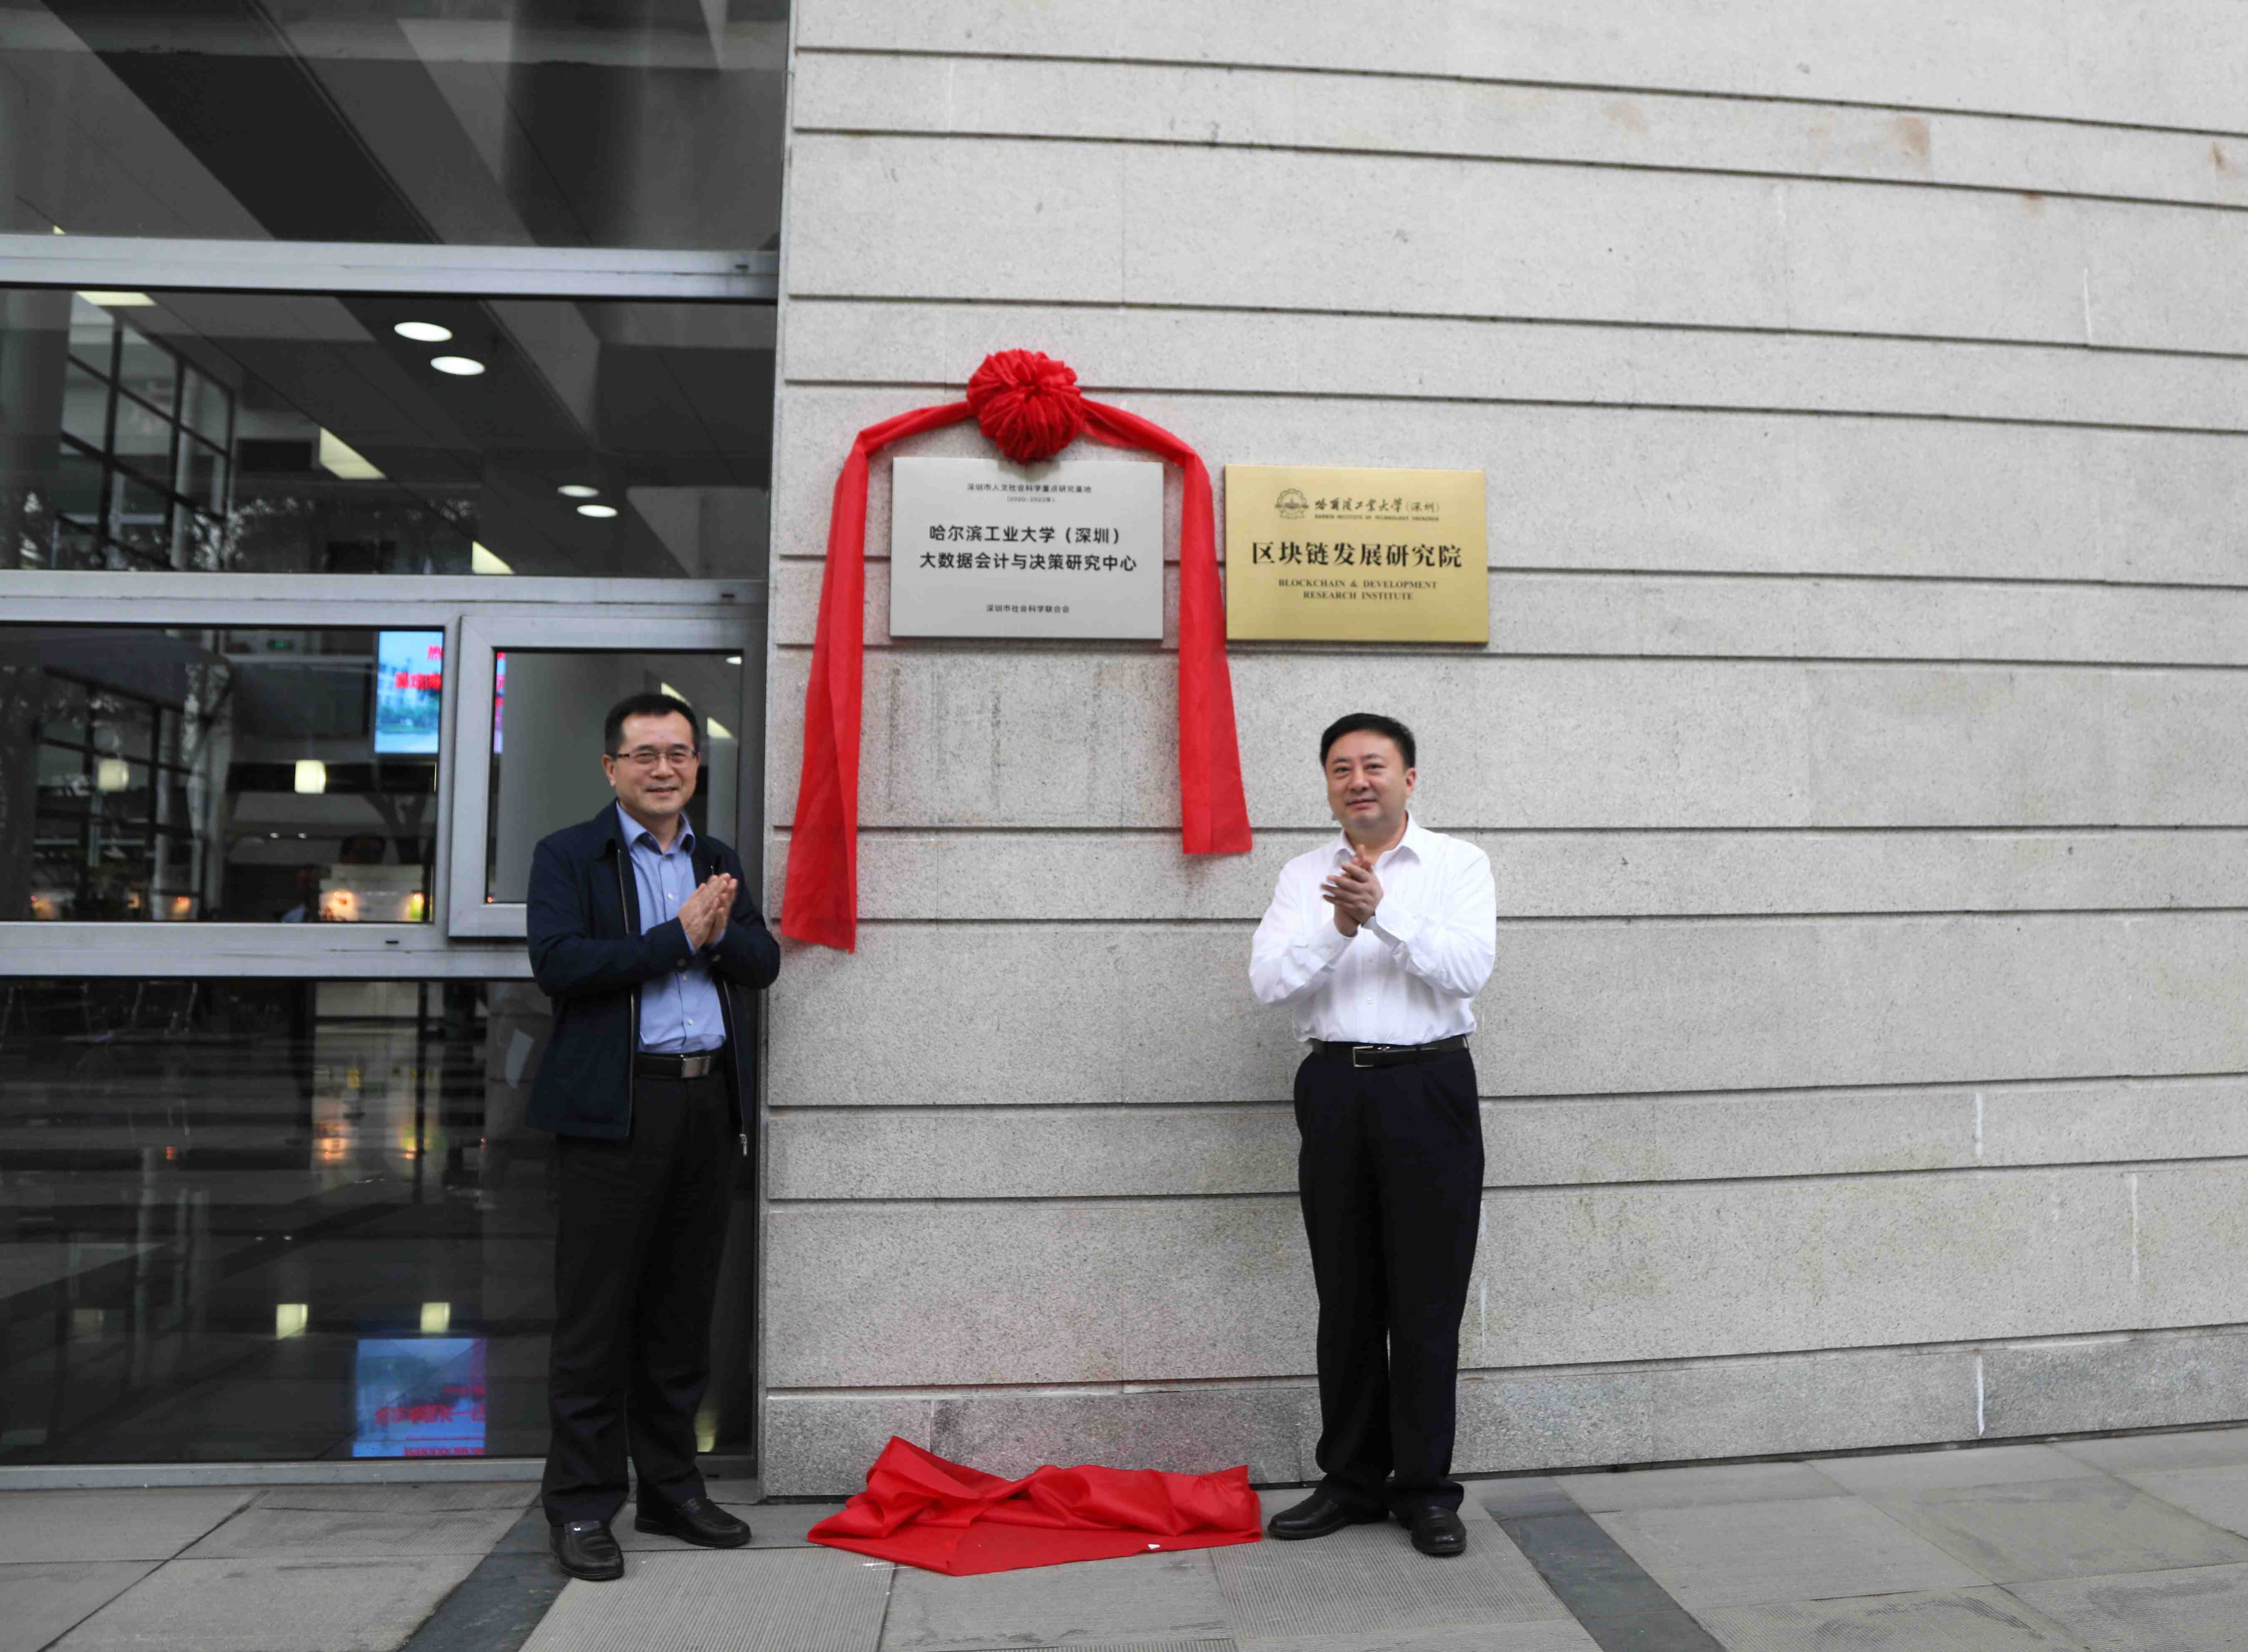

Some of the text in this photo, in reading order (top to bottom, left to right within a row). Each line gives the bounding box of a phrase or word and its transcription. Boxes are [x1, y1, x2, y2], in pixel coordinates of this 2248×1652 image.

[929, 525, 1120, 545] 哈尔滨工业大学（深圳）
[920, 552, 1137, 572] 大数据会计与决策研究中心
[1252, 541, 1462, 568] 区块链发展研究院
[1363, 580, 1437, 589] DEVELOPMENT
[1303, 590, 1414, 600] RESEARCH INSTITUTE
